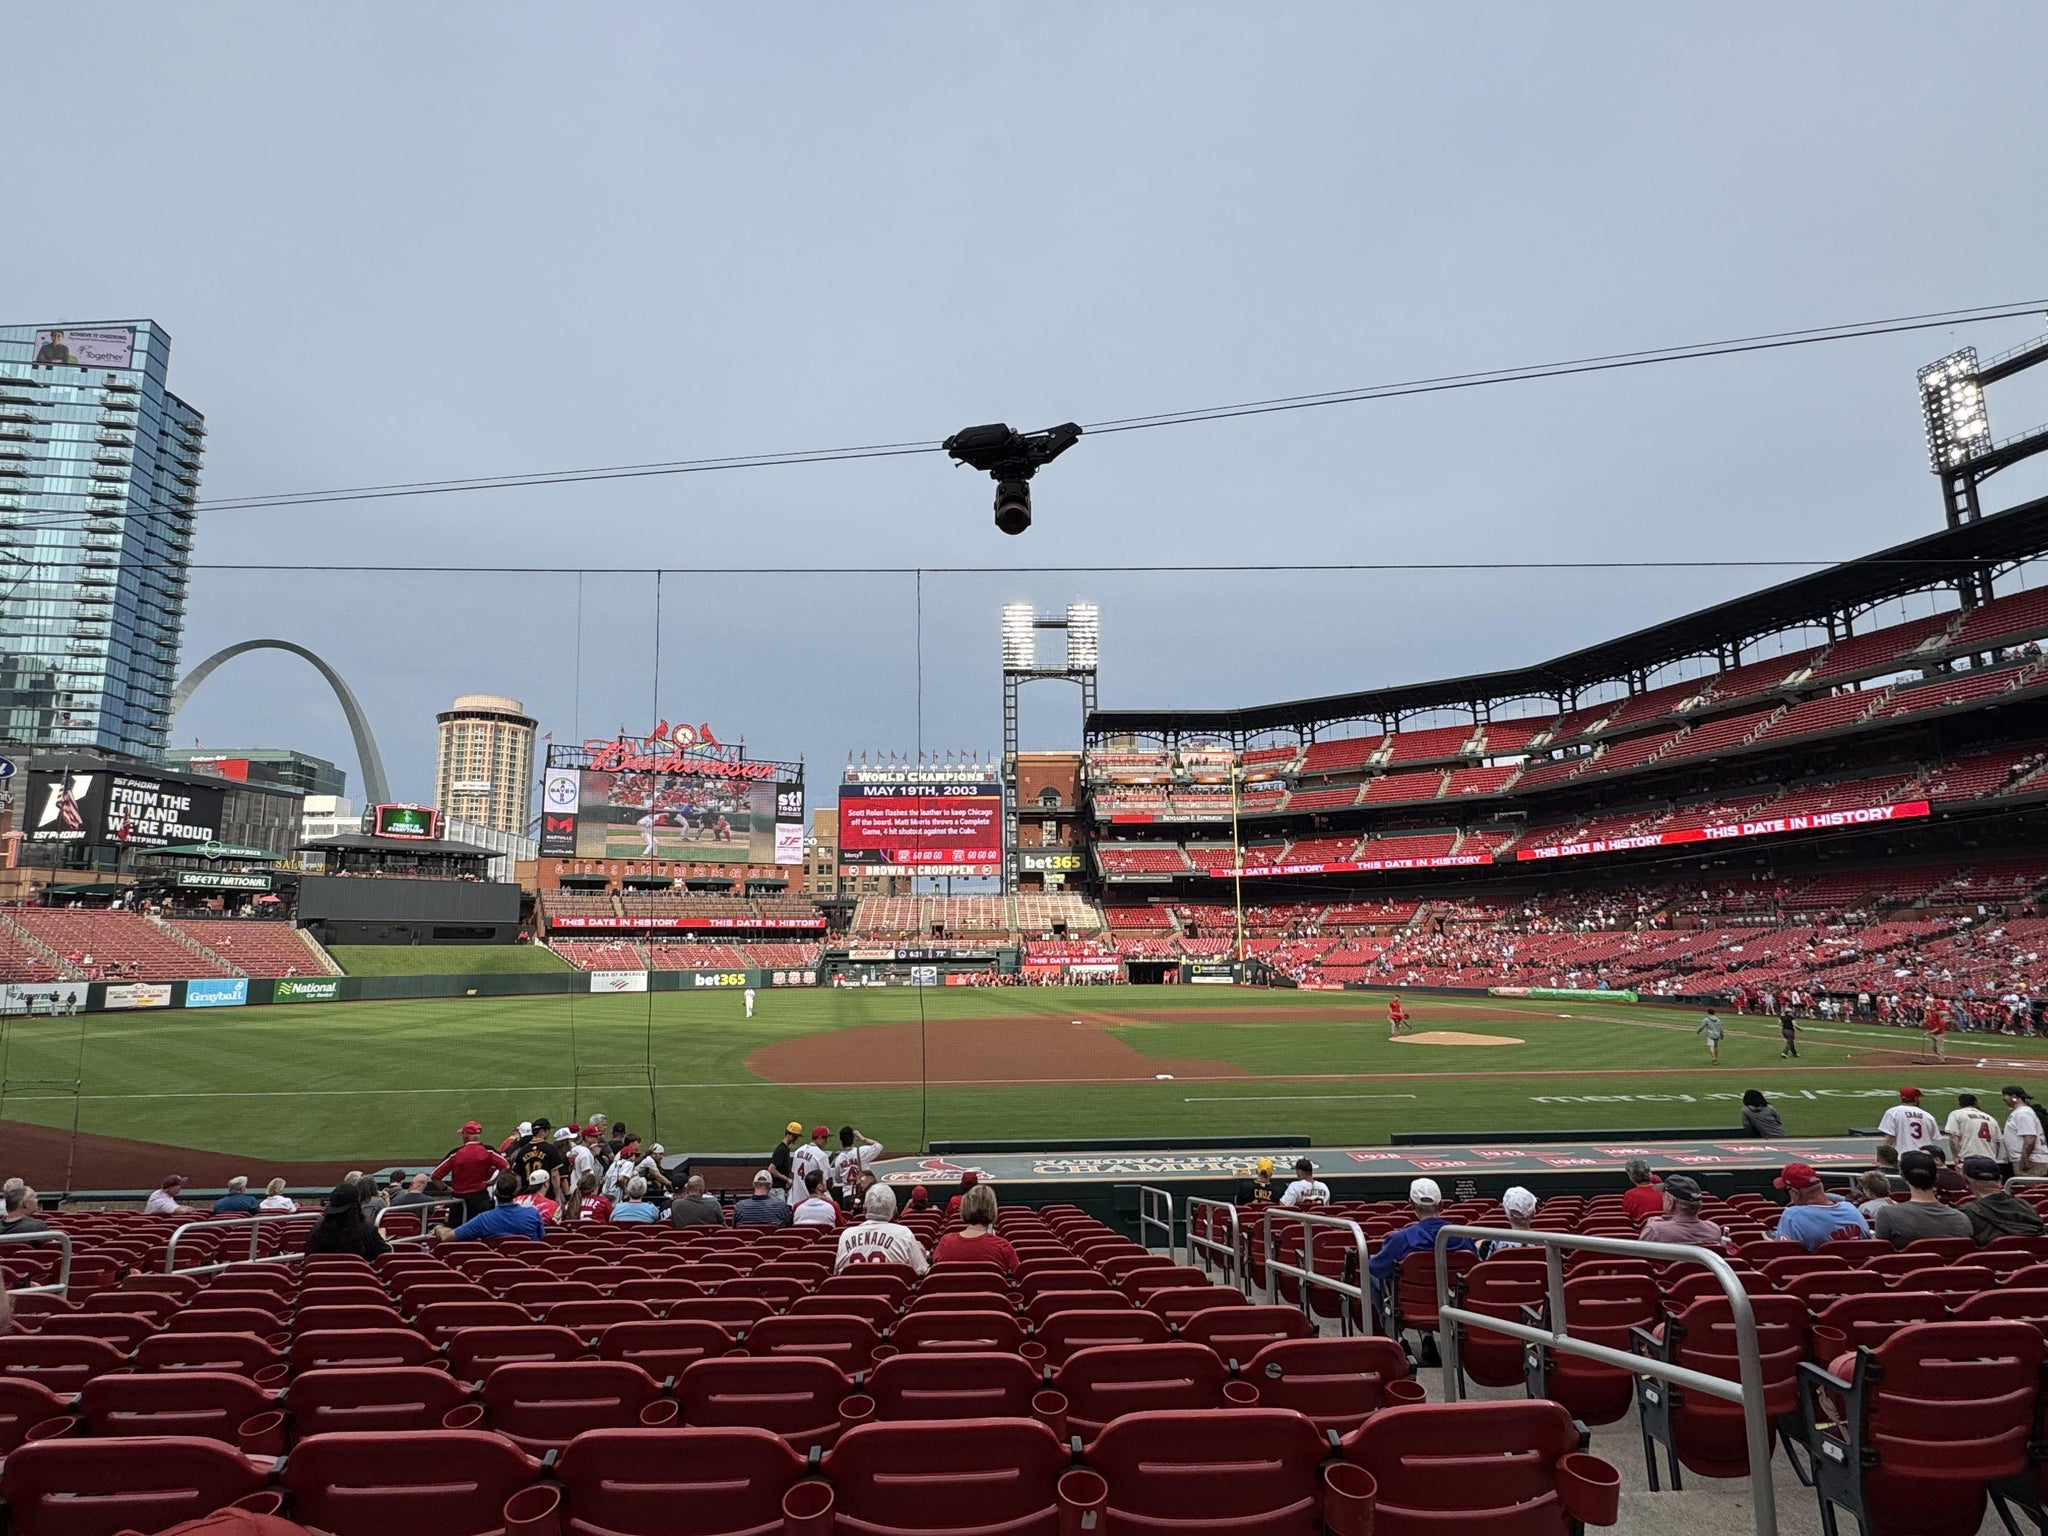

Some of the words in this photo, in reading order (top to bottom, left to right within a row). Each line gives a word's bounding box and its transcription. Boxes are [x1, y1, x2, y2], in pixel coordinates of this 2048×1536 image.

[85, 351, 123, 361] Together
[584, 740, 776, 778] Budweiser
[857, 772, 905, 782] WORLD
[908, 773, 985, 783] CHAMPIONS
[113, 777, 126, 786] 1ST
[127, 779, 160, 791] PHORM
[863, 786, 896, 796] MAY
[900, 786, 939, 797] 19TH,
[944, 787, 978, 796] 2003
[111, 787, 158, 806] FROM
[161, 794, 192, 811] THE
[778, 791, 802, 807] stl
[109, 801, 141, 818] LOU
[144, 807, 179, 823] AND
[951, 809, 966, 818] keep
[967, 809, 993, 817] Chicago
[851, 818, 861, 826] off
[862, 818, 872, 826] the
[873, 818, 893, 826] board.
[894, 818, 909, 826] Matt
[932, 818, 953, 826] throws
[960, 818, 990, 827] Complete
[1703, 824, 1739, 840] THIS
[1743, 819, 1785, 835] DATE
[1790, 817, 1808, 830] IN
[1813, 806, 1894, 828] HISTORY
[33, 831, 47, 839] 1ST
[162, 819, 213, 841] PROUD
[862, 828, 881, 836] Game,
[924, 828, 947, 837] against
[1534, 847, 1558, 859] THIS
[1562, 842, 1591, 856] DATE
[1593, 841, 1606, 852] IN
[1608, 834, 1663, 851] HISTORY
[1025, 855, 1081, 869] bet365
[1356, 861, 1382, 870] THIS
[1385, 859, 1412, 869] DATE
[1416, 859, 1428, 867] IN
[1431, 856, 1481, 867] HISTORY
[574, 864, 580, 874] 1
[585, 864, 592, 874] 2
[624, 865, 635, 876] 10
[657, 866, 668, 876] 17
[729, 868, 742, 878] 42
[747, 868, 760, 878] 45
[865, 865, 905, 875] BROWN
[908, 867, 915, 875] &
[917, 865, 974, 875] CROUPPEN
[1222, 868, 1244, 876] THIS
[1246, 867, 1269, 875] DATE
[1272, 866, 1283, 874] IN
[1284, 864, 1325, 873] HISTORY
[182, 875, 219, 884] SAFETY
[220, 876, 266, 887] NATIONAL
[560, 918, 586, 927] THIS
[589, 918, 617, 927] DATE
[620, 918, 632, 927] IN
[634, 918, 679, 927] HISTORY
[710, 919, 731, 927] THIS
[736, 919, 761, 927] DATE
[765, 919, 774, 927] IN
[778, 919, 821, 927] HISTORY
[695, 973, 746, 986] bet365
[292, 982, 336, 993] National
[1910, 1121, 1922, 1140] 3
[1977, 1122, 1992, 1143] 4
[1176, 1155, 1306, 1164] LEAGUE
[1421, 1160, 1467, 1168] 1930
[797, 1162, 805, 1181] 4
[846, 1166, 858, 1184] 4
[1254, 1188, 1273, 1201] CRUZ
[845, 1231, 894, 1253] ARENADO
